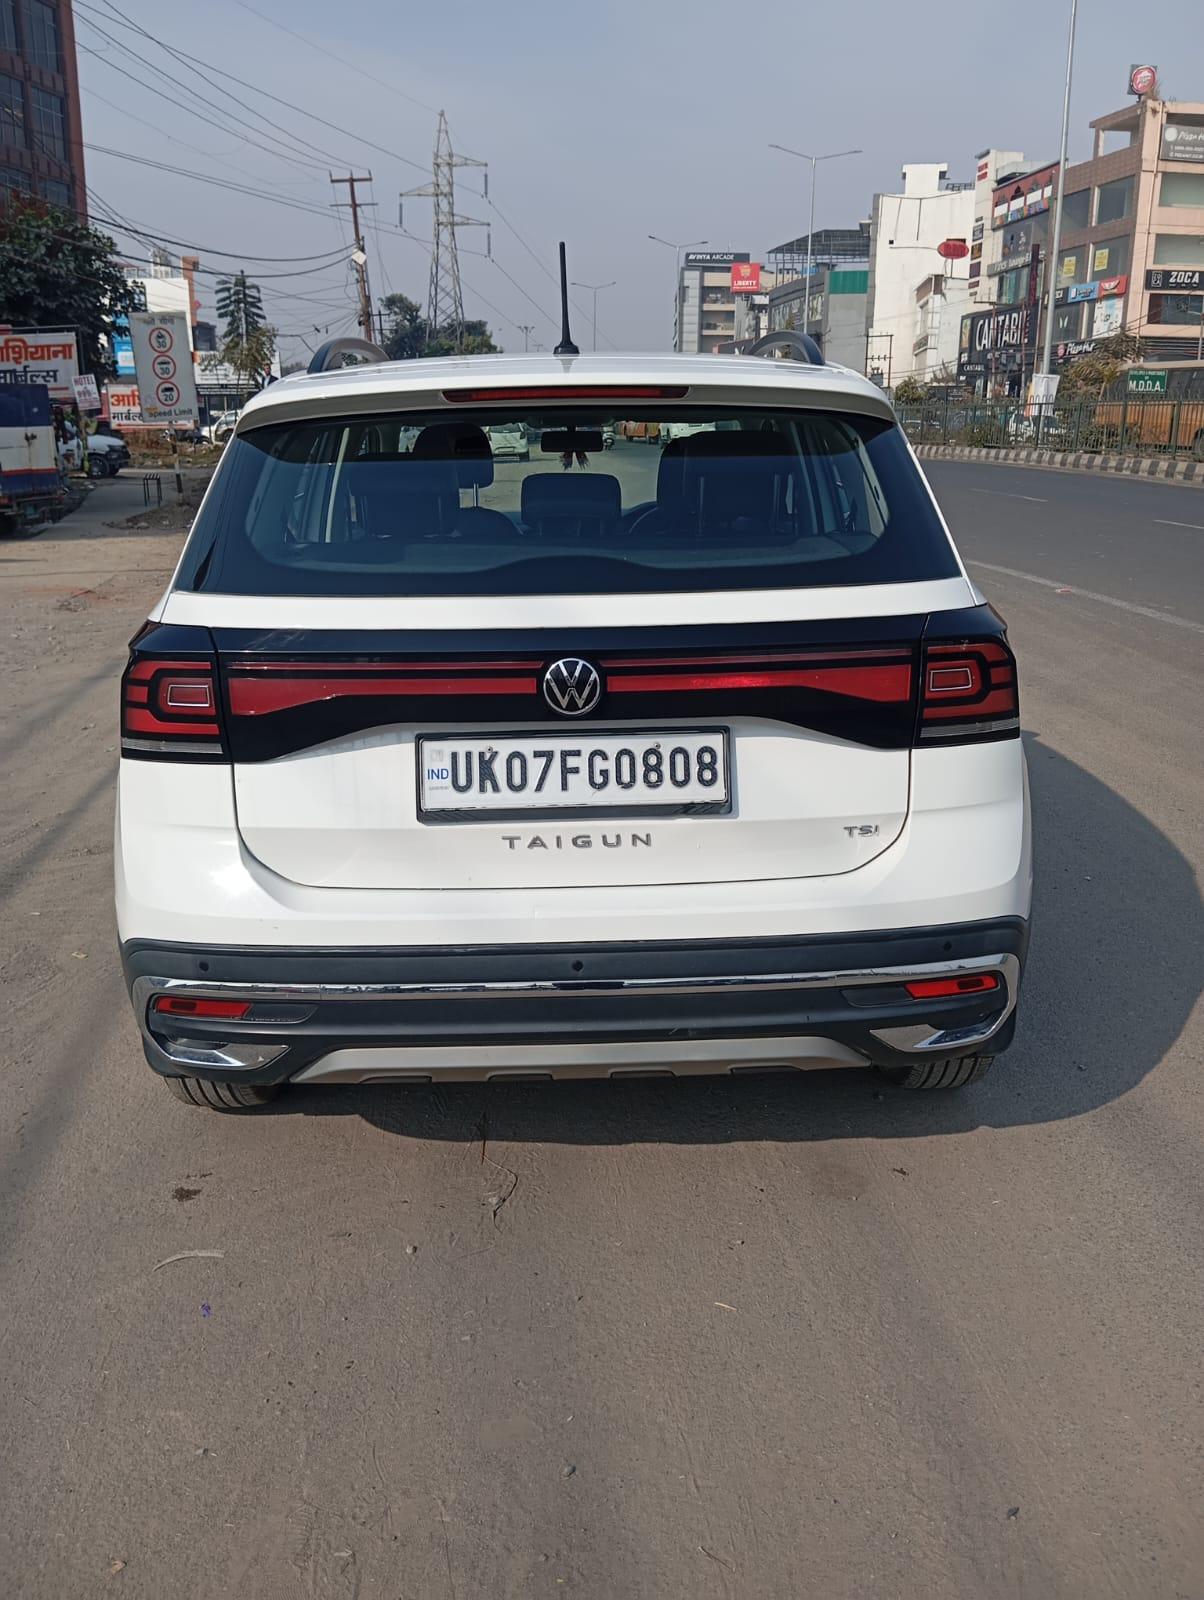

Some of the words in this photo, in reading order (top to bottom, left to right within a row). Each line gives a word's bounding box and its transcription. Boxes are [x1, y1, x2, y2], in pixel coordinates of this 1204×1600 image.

[1168, 271, 1200, 284] ZOCA
[975, 311, 1028, 351] CANTABIL
[156, 340, 167, 349] 30
[160, 366, 171, 375] 30
[74, 375, 96, 387] HOTEL
[1128, 380, 1164, 392] M.D.D.A.
[163, 393, 174, 402] 20
[174, 408, 193, 416] Limit
[427, 767, 450, 781] IND
[450, 745, 719, 793] UK07FG0808
[501, 832, 654, 850] TAIGUN
